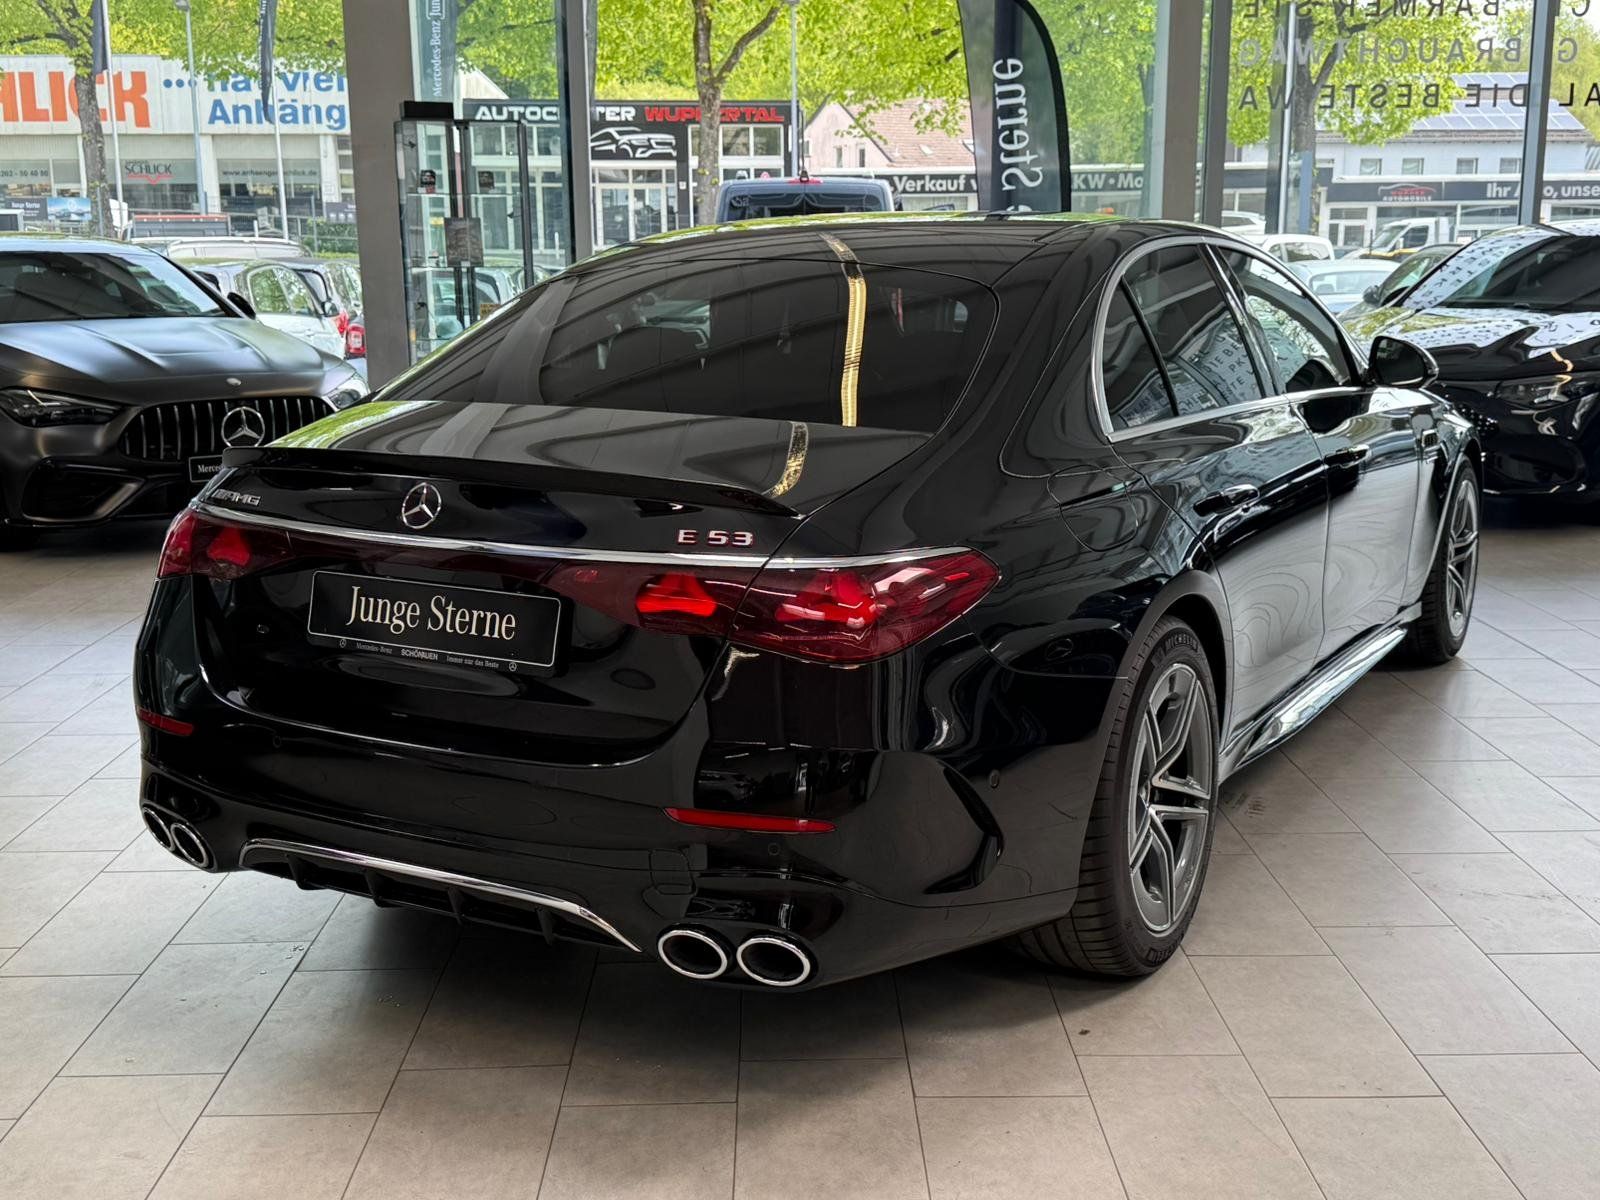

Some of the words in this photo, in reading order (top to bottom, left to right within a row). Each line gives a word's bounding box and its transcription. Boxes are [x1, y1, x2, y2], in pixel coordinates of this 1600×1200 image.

[893, 174, 967, 193] Verkauf
[1072, 173, 1106, 190] KW
[1486, 182, 1512, 198] Ihr
[677, 529, 697, 543] E
[708, 530, 753, 546] 53
[346, 585, 421, 635] Junge
[426, 594, 517, 641] Sterne
